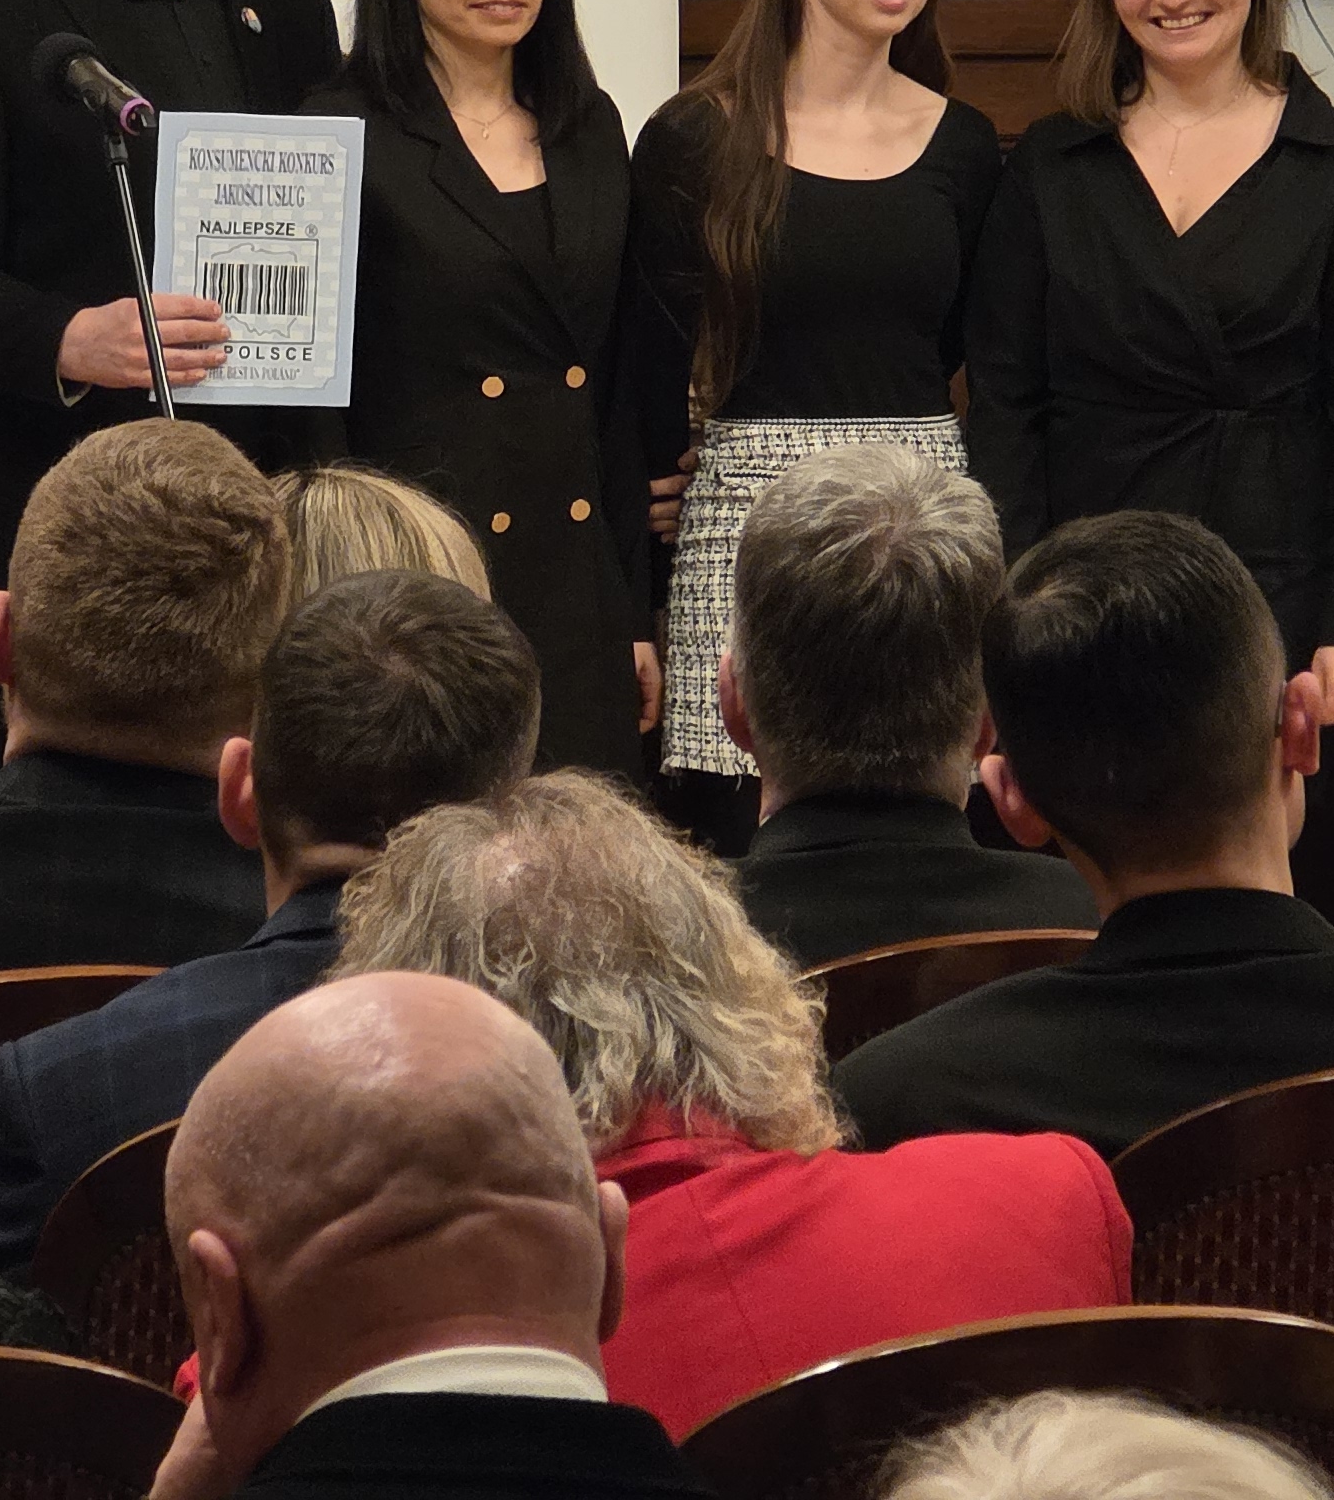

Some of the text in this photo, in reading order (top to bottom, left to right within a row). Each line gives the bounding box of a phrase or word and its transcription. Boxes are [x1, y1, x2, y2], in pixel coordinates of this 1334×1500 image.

[189, 147, 335, 176] KONSUMENCKI KONKURS
[199, 219, 296, 237] NAJLEPSZE
[224, 345, 313, 362] POLSCE
